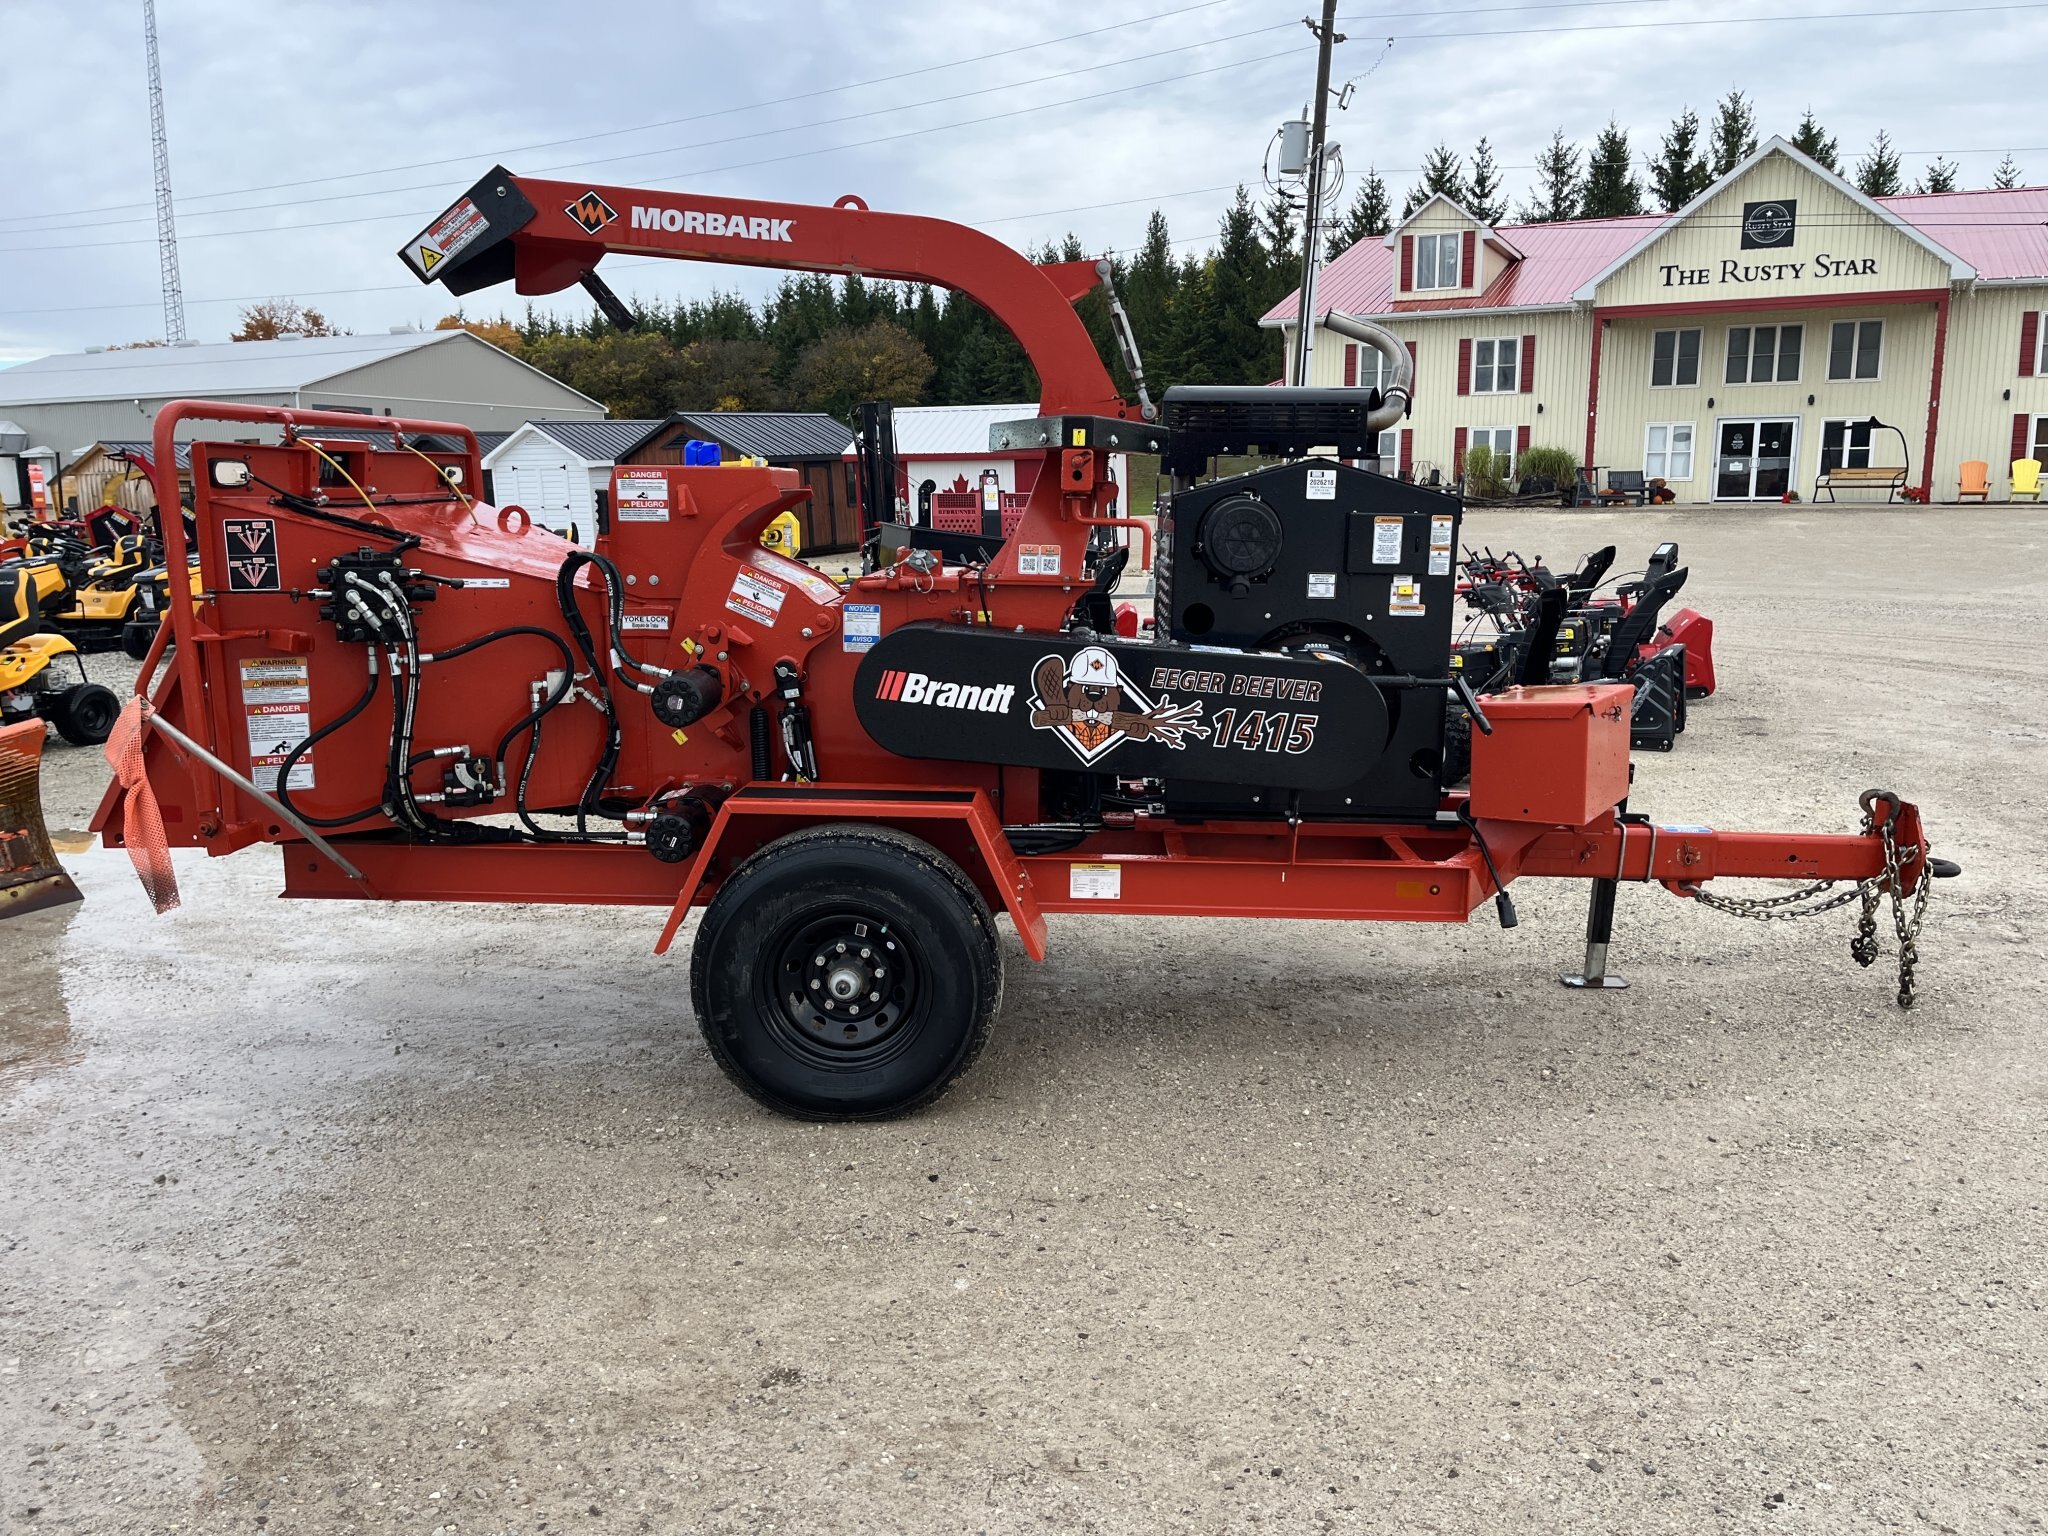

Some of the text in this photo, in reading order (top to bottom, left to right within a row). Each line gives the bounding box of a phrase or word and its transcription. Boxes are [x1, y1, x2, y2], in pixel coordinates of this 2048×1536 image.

[442, 207, 461, 225] DANGER
[631, 205, 793, 242] MORBARK
[1745, 220, 1792, 230] RUSTY STAR
[453, 220, 473, 238] PELIGRO
[1659, 253, 1878, 287] THE RUSTY STAR
[631, 500, 665, 508] PELIGRO
[754, 572, 782, 590] DANGER
[742, 598, 772, 616] PELIGRO
[261, 679, 299, 687] ADVERTENCIA
[1150, 667, 1323, 702] EEGER BEEVER
[901, 672, 1015, 714] Brandt
[262, 704, 301, 713] DANGER
[1212, 707, 1319, 755] 1415
